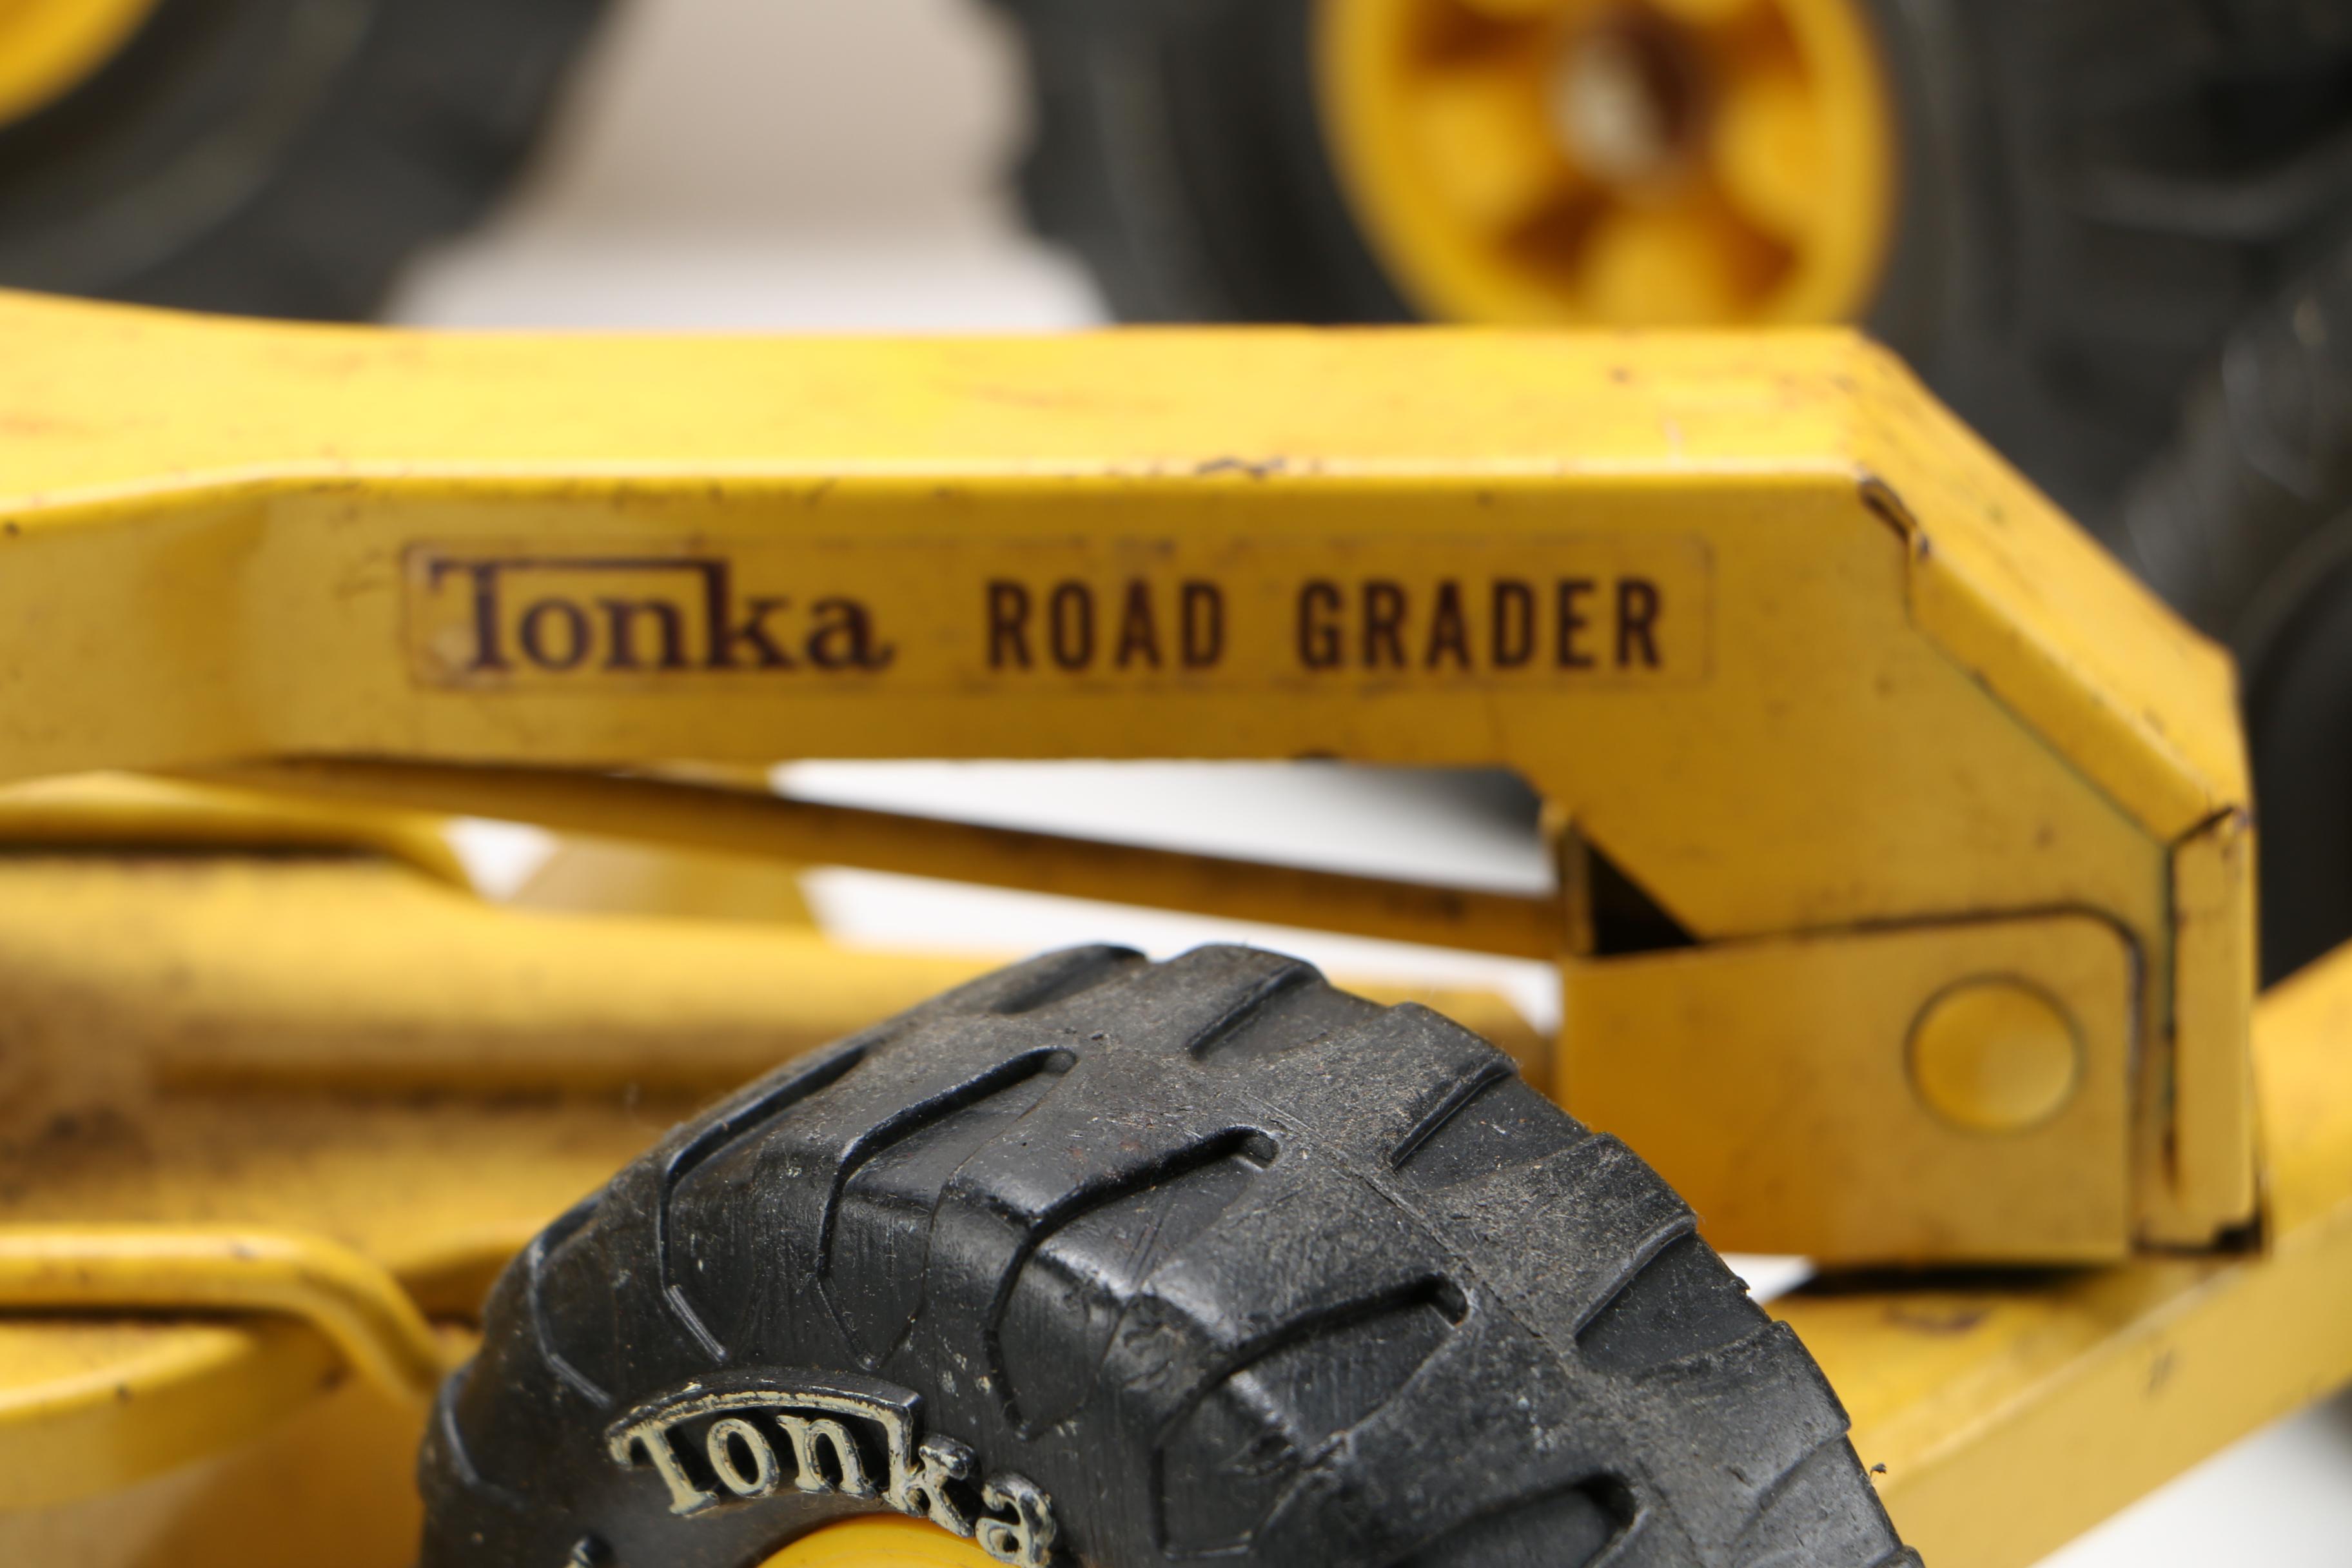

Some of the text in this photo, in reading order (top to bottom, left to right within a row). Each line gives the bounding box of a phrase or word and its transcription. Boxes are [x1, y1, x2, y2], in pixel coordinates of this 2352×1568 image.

[428, 556, 1665, 674] Tonka ROAD GRADER
[605, 1366, 1057, 1568] Tonka
